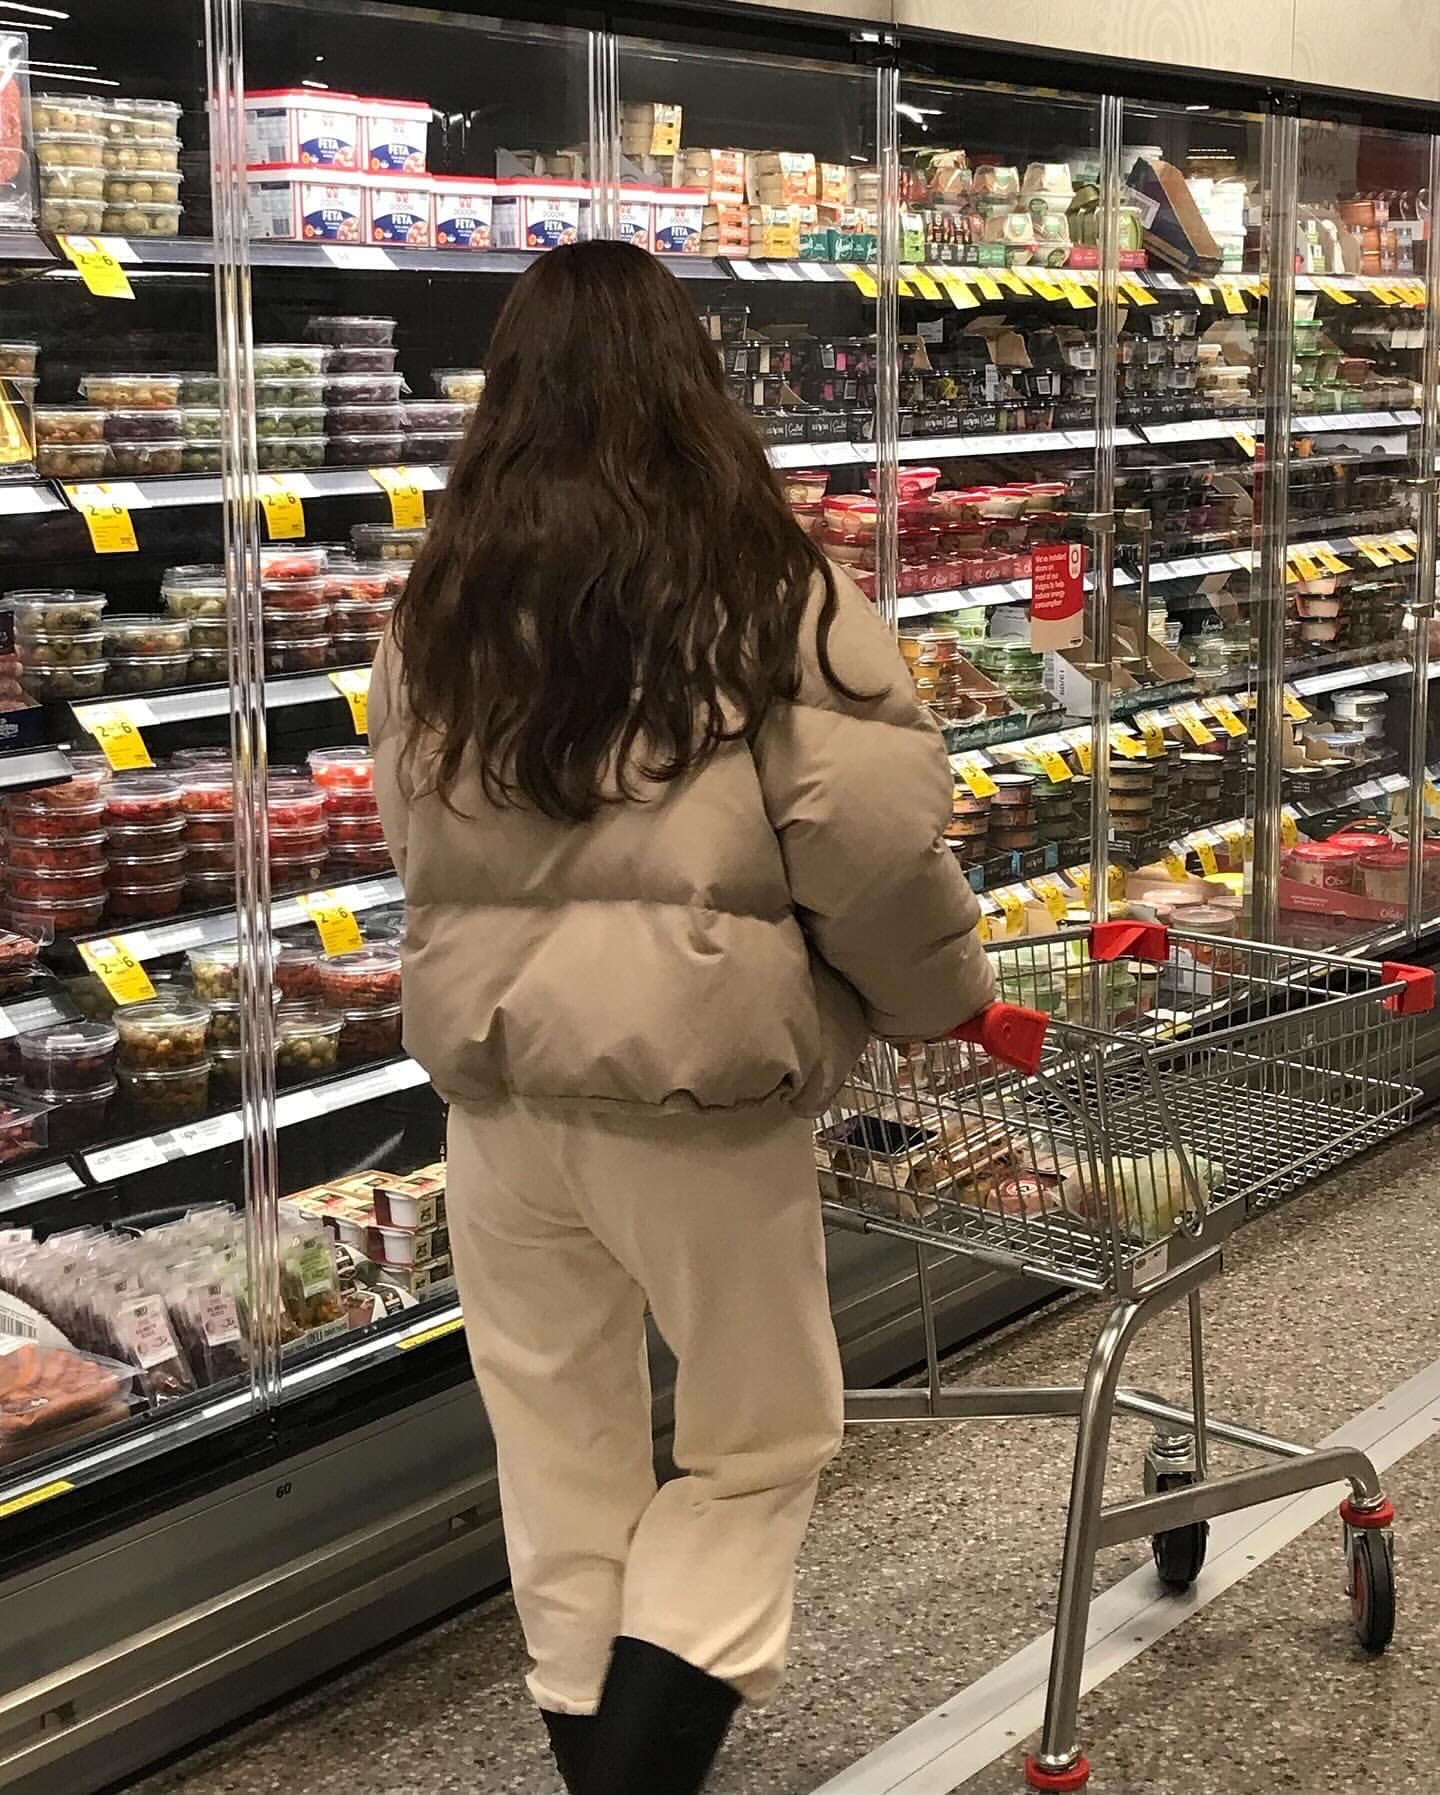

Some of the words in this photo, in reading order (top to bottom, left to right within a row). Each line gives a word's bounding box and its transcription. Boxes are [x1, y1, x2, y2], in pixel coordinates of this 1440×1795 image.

[318, 137, 339, 150] FETA
[388, 144, 410, 155] FETA
[322, 210, 343, 221] FETA
[391, 214, 413, 225] FETA
[455, 218, 476, 229] FETA
[544, 220, 564, 231] FETA
[671, 226, 688, 236] FETA
[99, 962, 112, 975] 2
[276, 1482, 292, 1498] 60
